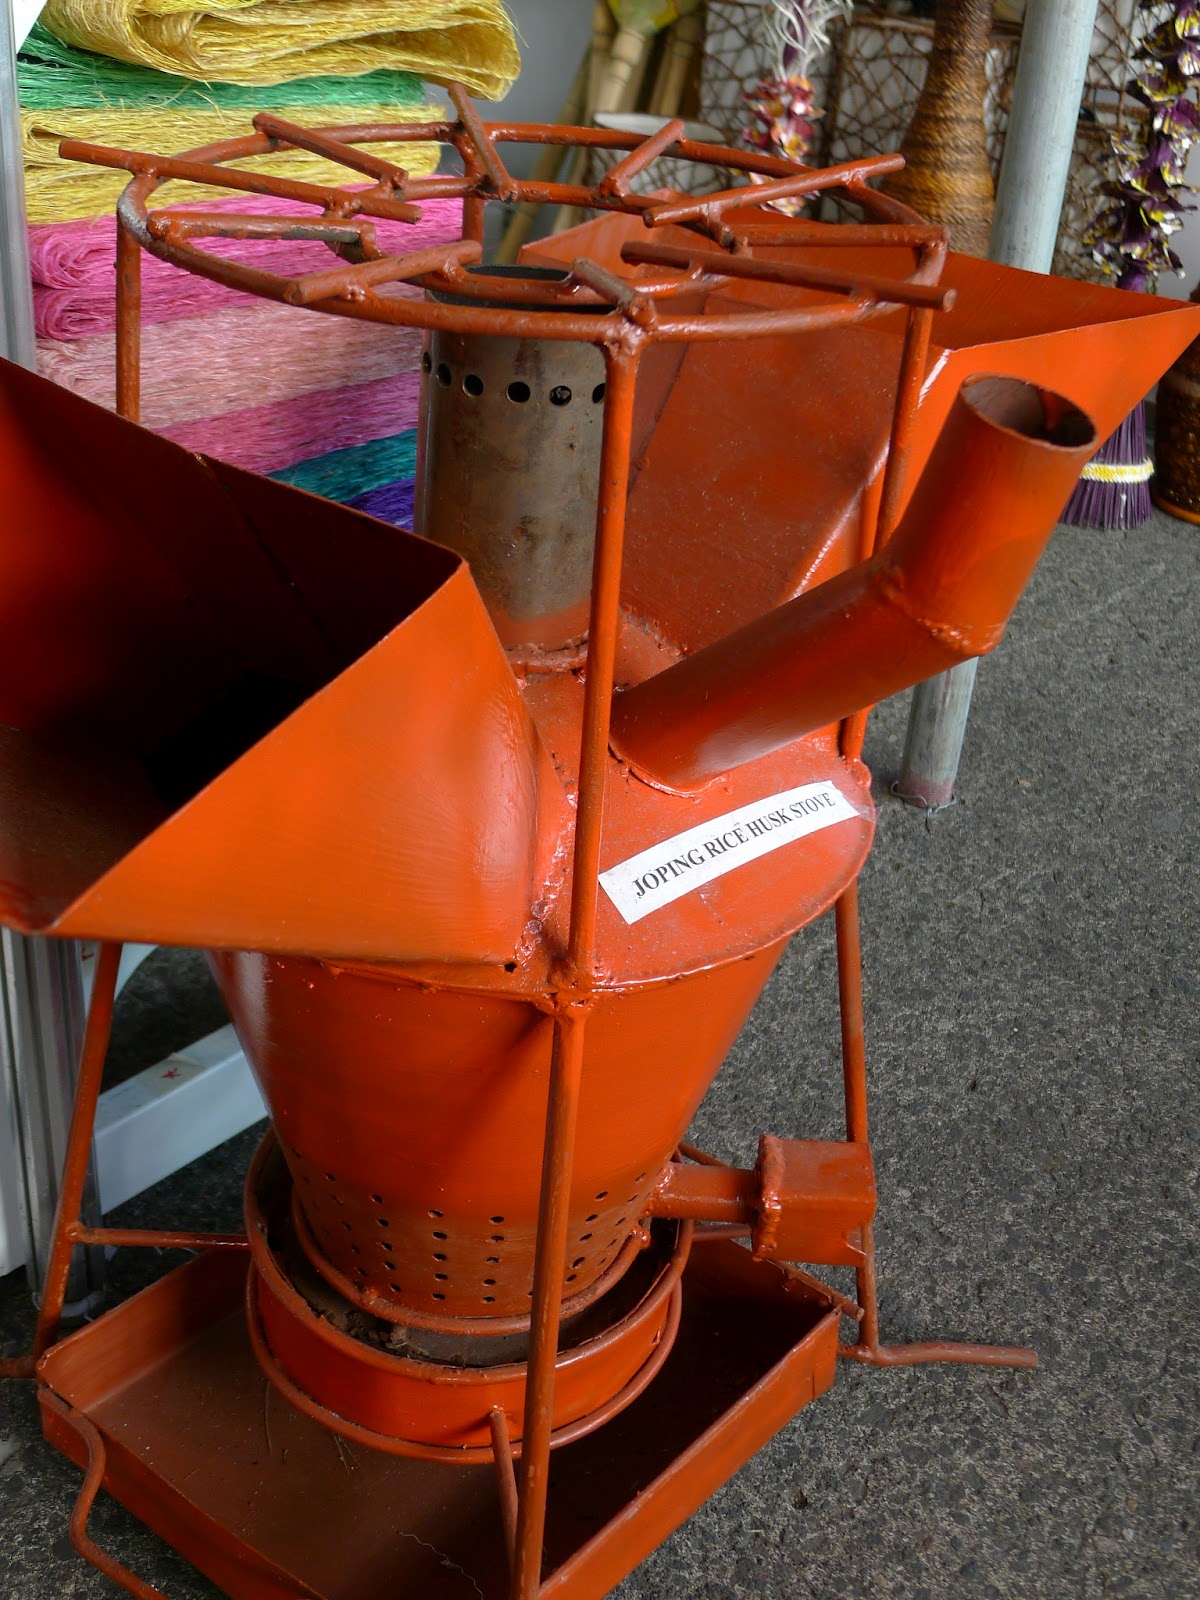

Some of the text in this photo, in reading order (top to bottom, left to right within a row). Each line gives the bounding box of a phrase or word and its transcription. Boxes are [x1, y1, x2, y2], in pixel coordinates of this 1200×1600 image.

[632, 792, 836, 897] JOPING RICE HUSK STOVE
